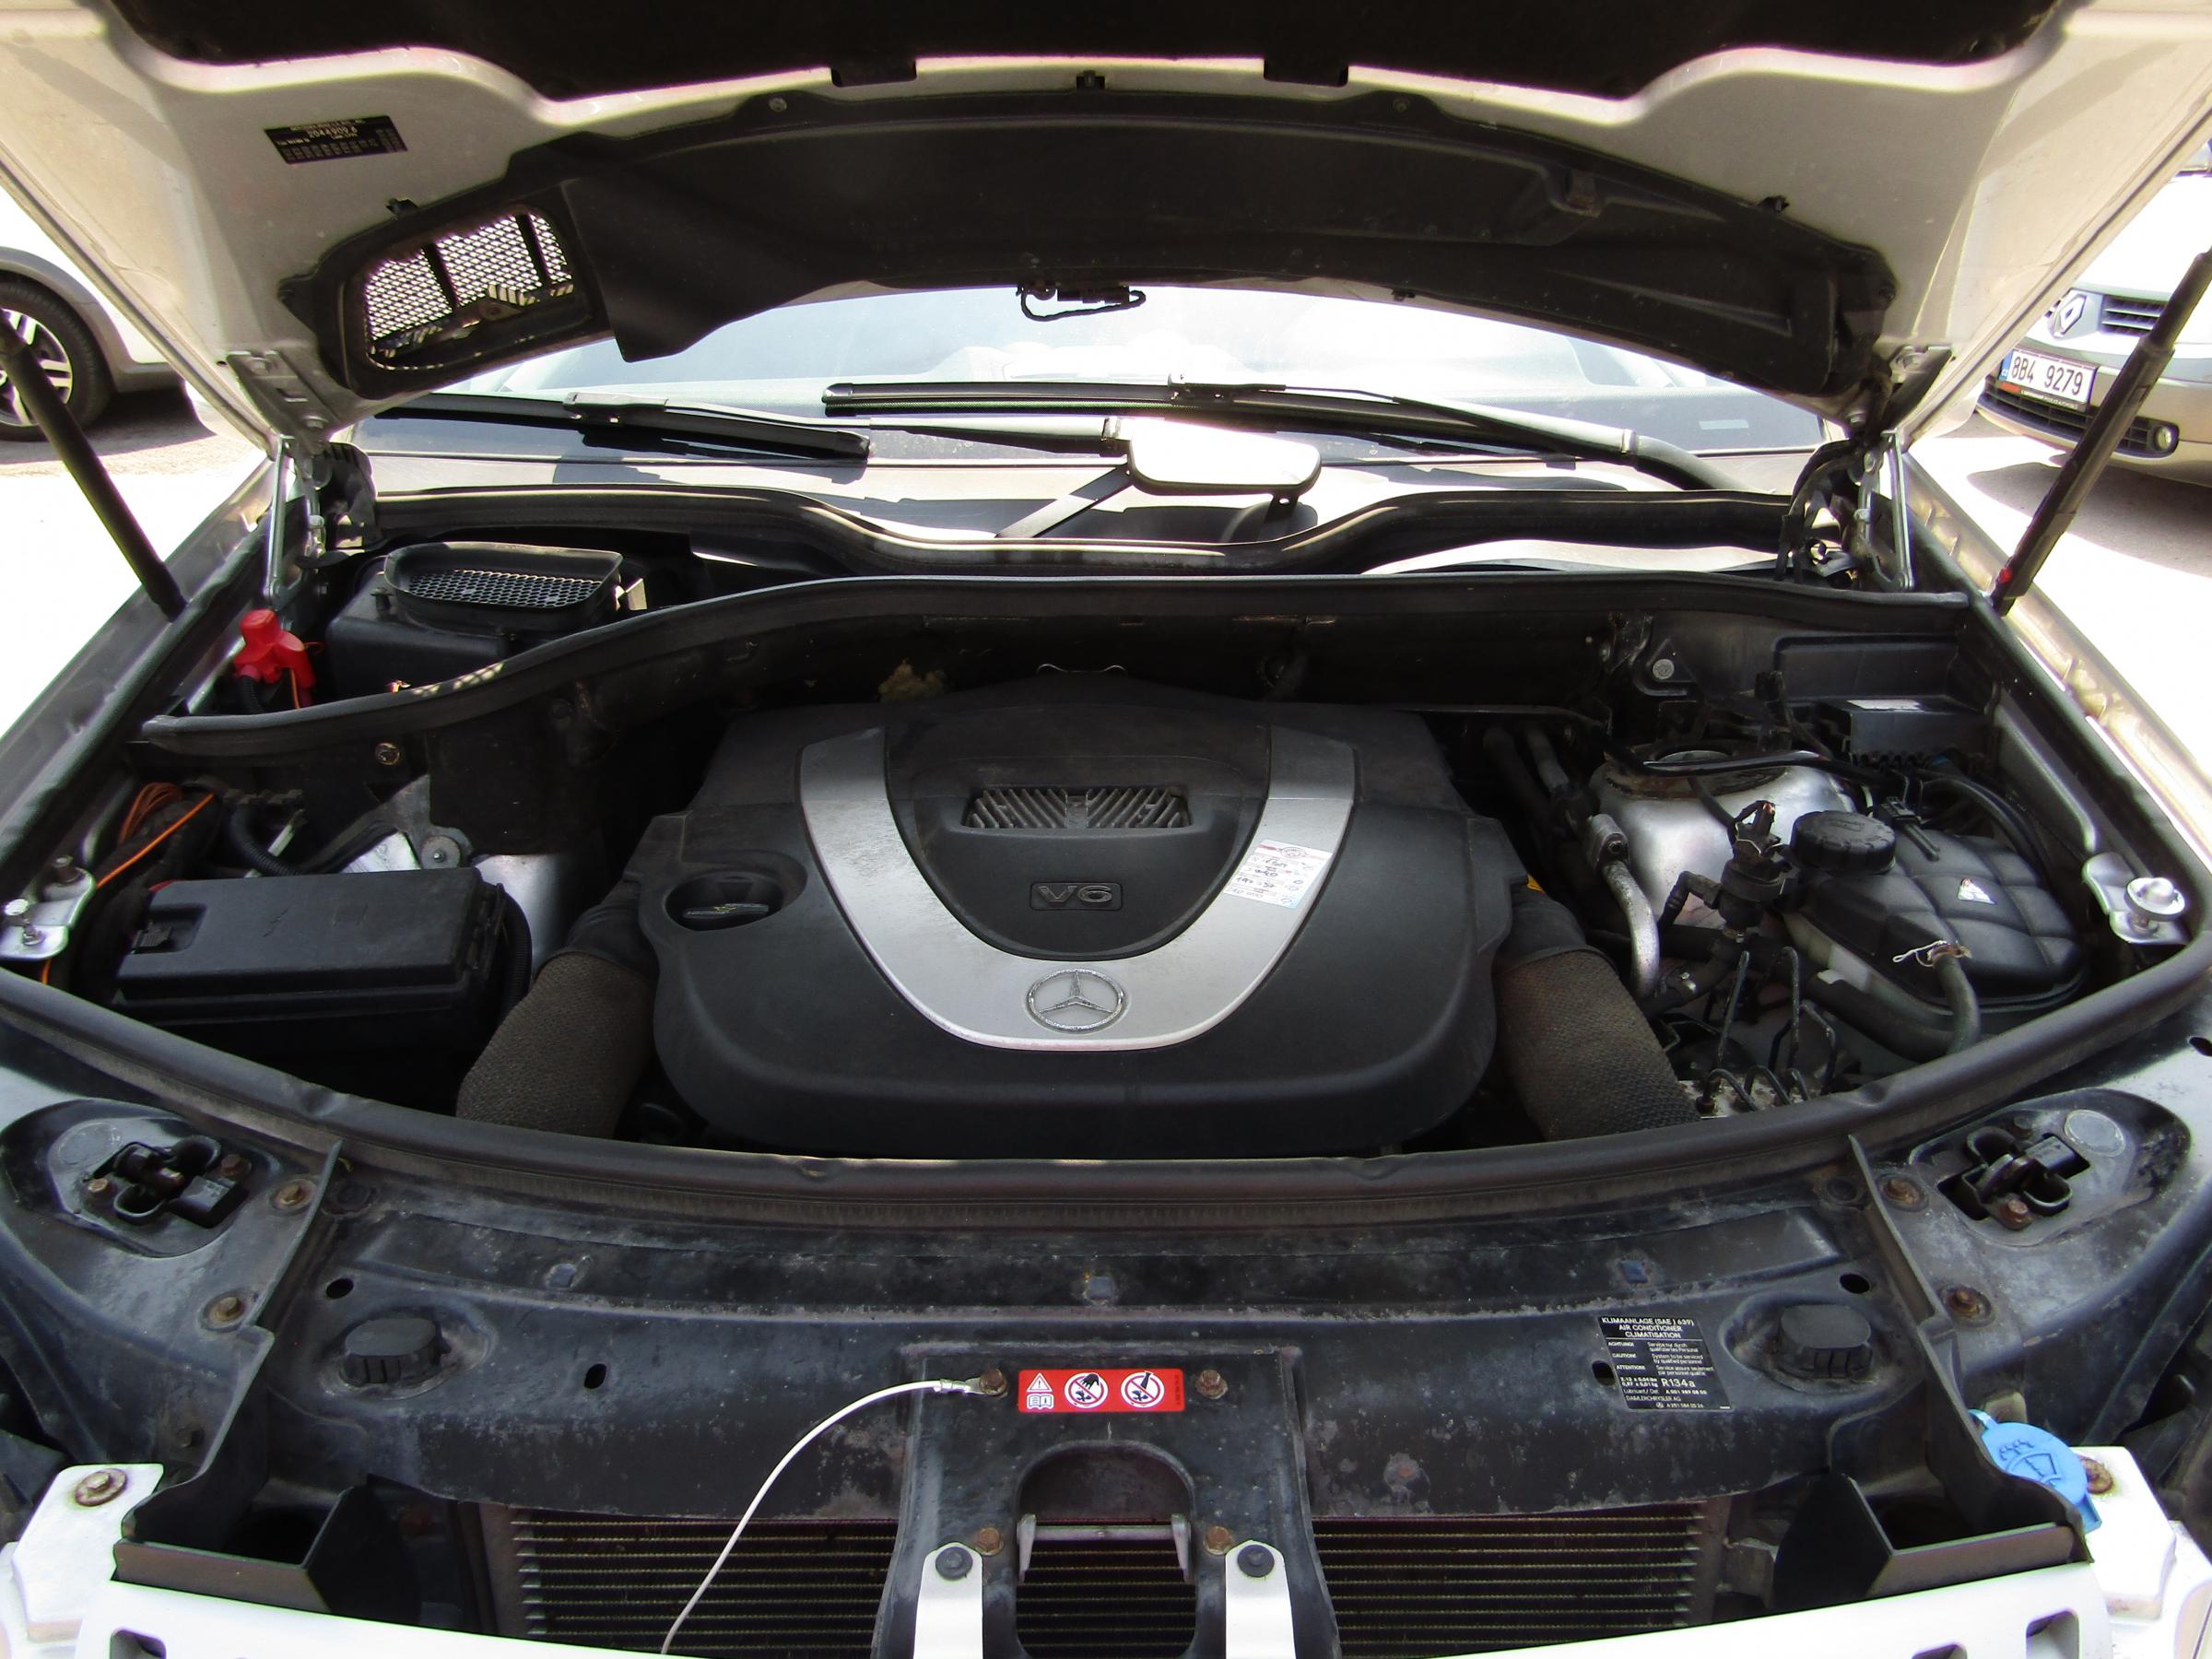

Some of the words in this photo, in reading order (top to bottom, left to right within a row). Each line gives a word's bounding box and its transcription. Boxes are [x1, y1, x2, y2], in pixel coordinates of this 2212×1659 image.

[2011, 356, 2036, 383] 8B4
[2044, 365, 2083, 395] 9279
[1038, 885, 1112, 903] V6
[1602, 1317, 1654, 1325] KLIMAANLAGE
[1632, 1324, 1683, 1333] CONDITIONER
[1661, 1378, 1696, 1388] R134a
